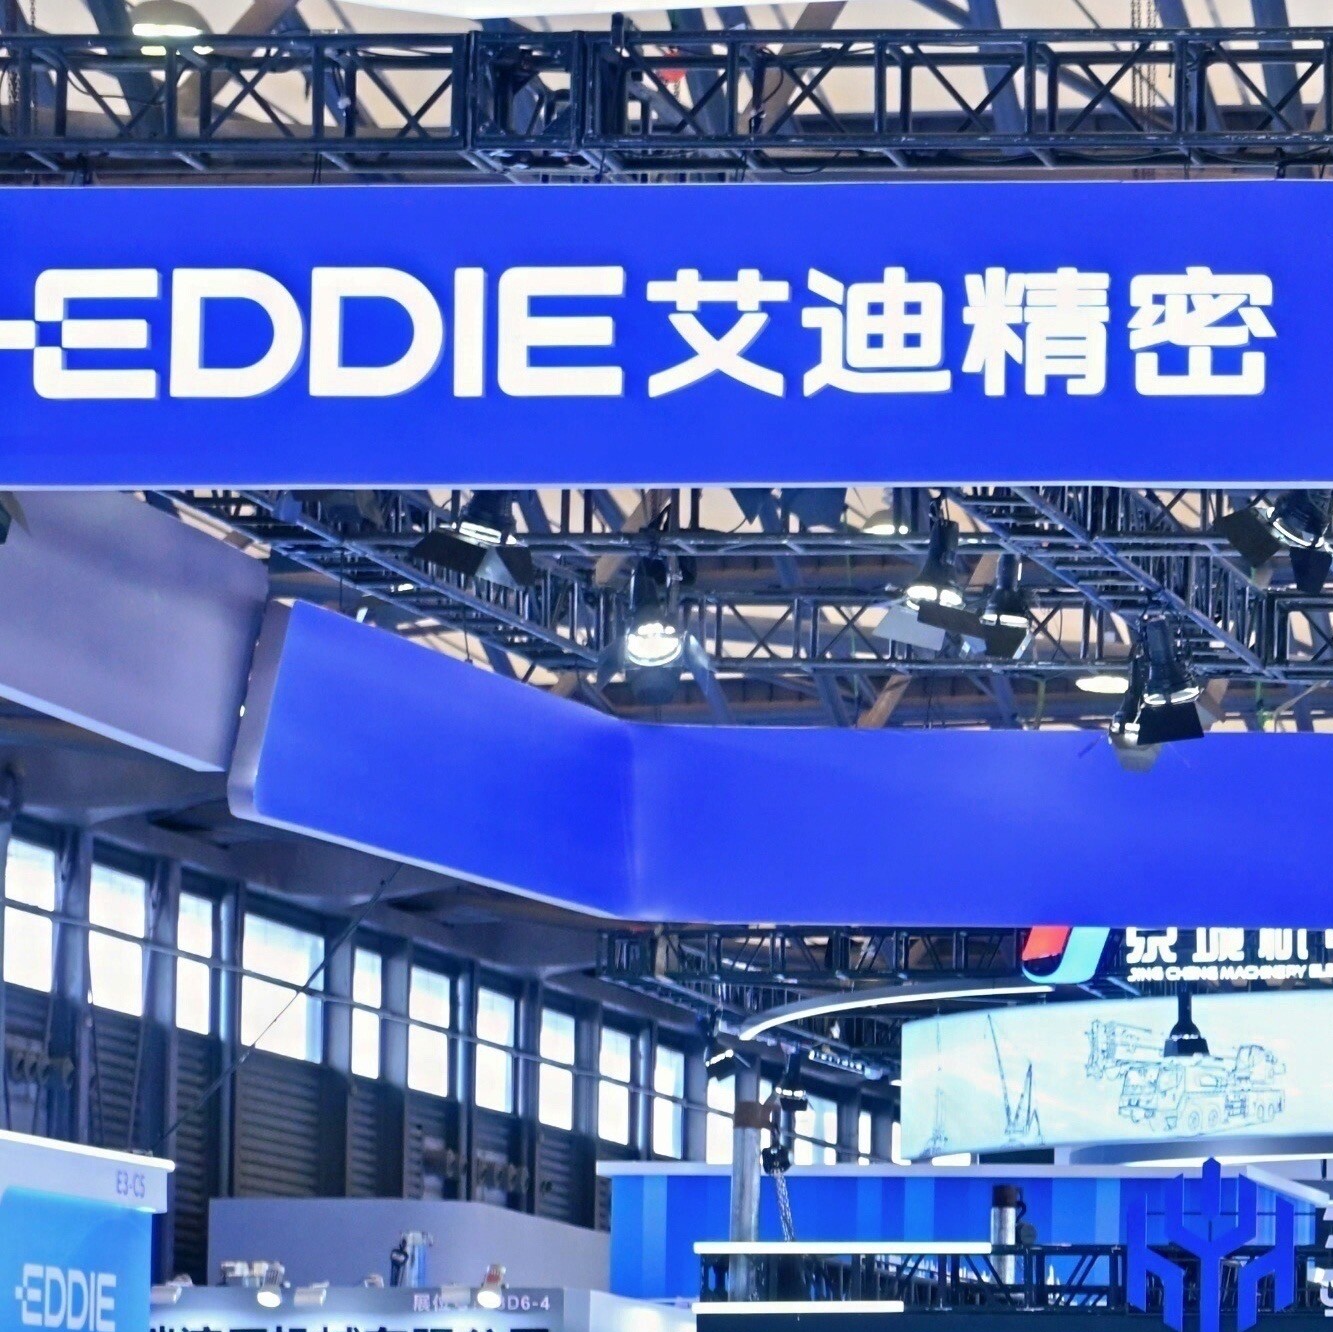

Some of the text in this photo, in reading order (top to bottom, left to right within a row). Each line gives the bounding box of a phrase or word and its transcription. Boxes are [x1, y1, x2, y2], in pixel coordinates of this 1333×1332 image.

[33, 265, 1278, 400] EDDIE 艾迪精密
[1220, 964, 1306, 980] MACHINERY
[116, 1170, 146, 1199] E3-C5
